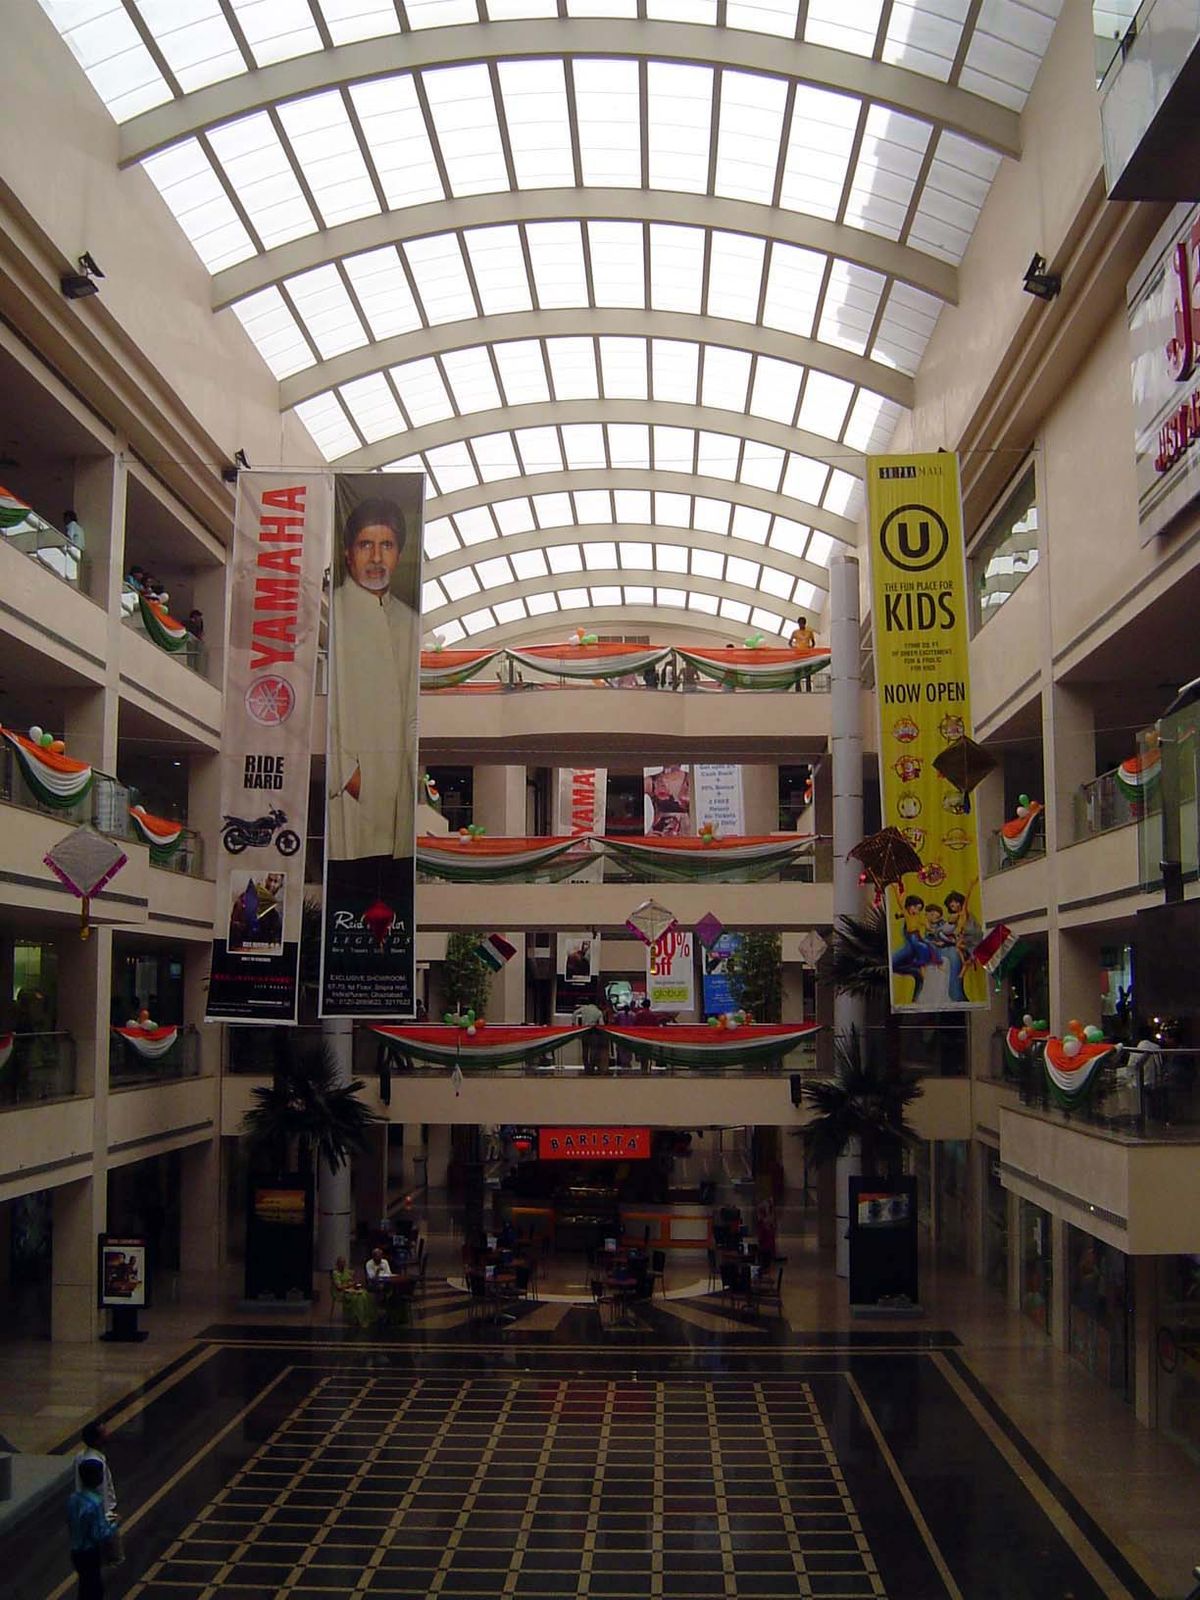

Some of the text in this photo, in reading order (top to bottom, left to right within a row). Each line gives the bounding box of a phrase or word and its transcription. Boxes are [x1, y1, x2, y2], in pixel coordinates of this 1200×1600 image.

[897, 522, 929, 559] U
[250, 486, 307, 669] YAMAHA
[885, 580, 954, 592] THE FUN PLACE FOR
[885, 591, 956, 631] KIDS
[885, 681, 965, 704] NOW OPEN
[245, 755, 284, 774] RIDE
[244, 774, 283, 790] HARD
[571, 768, 596, 837] YAMA
[550, 1133, 637, 1151] BARISTA
